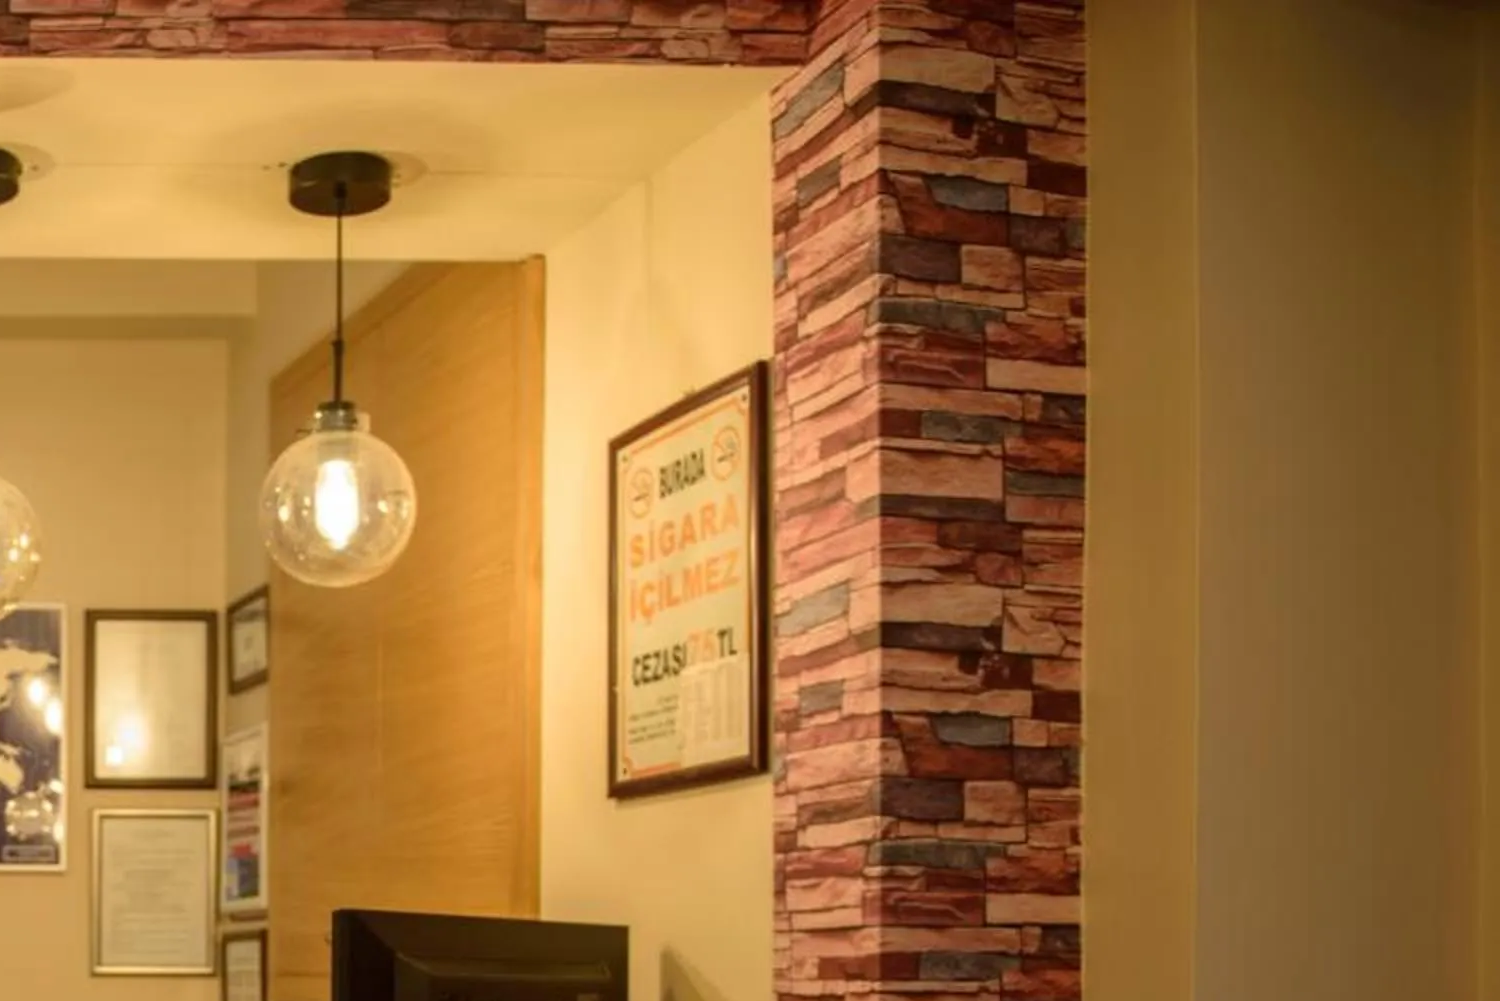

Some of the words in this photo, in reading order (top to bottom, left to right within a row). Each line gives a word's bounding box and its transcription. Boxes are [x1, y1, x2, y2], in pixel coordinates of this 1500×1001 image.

[658, 448, 706, 500] BURADA
[629, 492, 740, 568] SİGARA
[629, 549, 741, 624] İÇİLMEZ
[716, 625, 739, 660] TL
